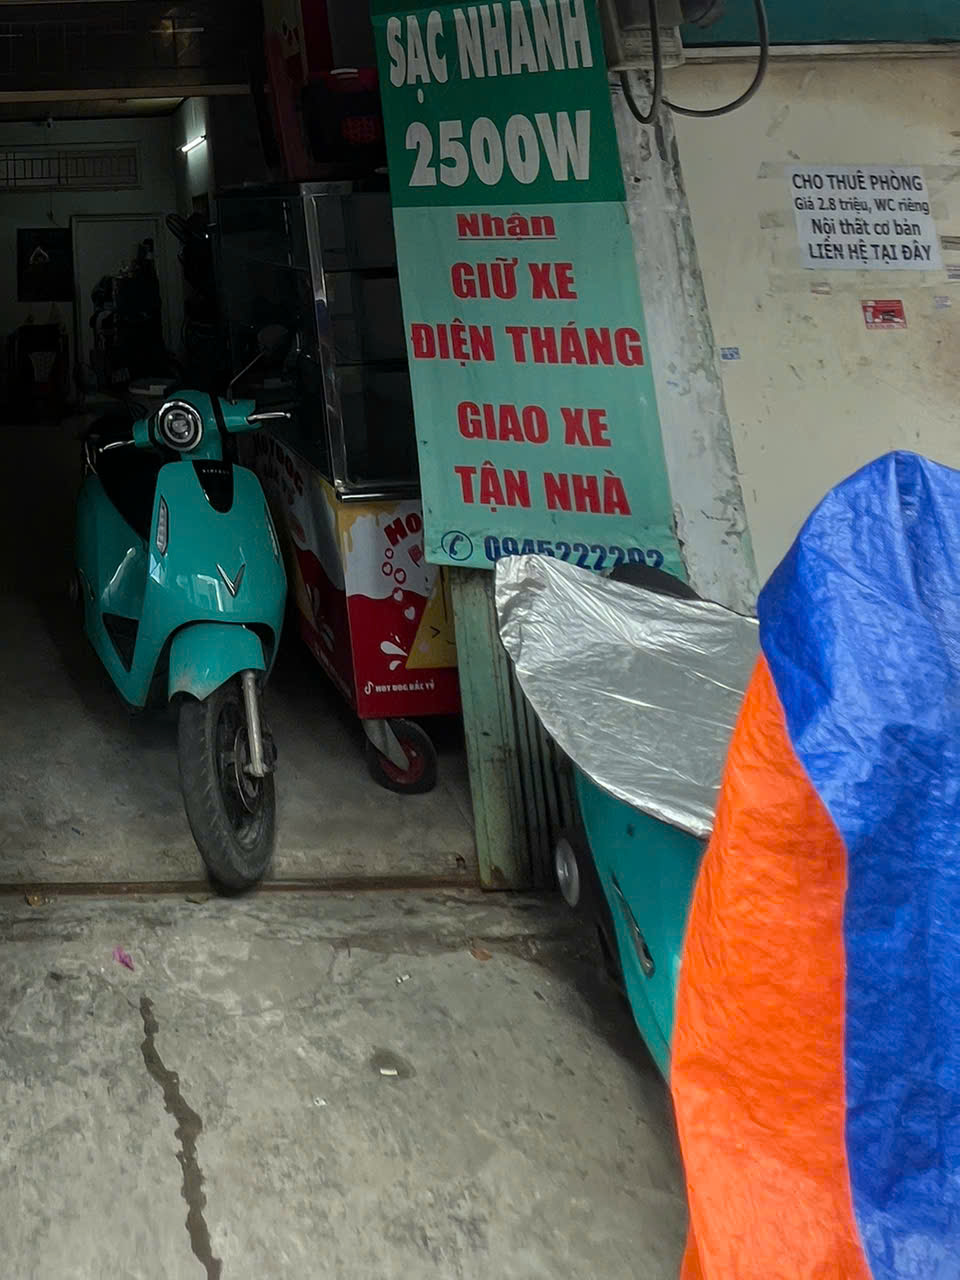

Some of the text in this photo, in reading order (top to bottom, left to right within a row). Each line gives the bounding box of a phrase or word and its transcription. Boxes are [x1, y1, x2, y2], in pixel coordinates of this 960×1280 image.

[386, 10, 449, 104] SẠC
[405, 110, 591, 188] 2500W
[792, 170, 923, 191] CHO THUÊ PHÒNG
[456, 213, 557, 241] Nhận
[794, 197, 815, 210] Giá
[818, 197, 837, 211] 2.8
[874, 198, 896, 211] WC
[898, 197, 930, 215] riêng
[811, 217, 922, 238] Nội thất cơ bản
[808, 237, 844, 260] LIÊN
[847, 239, 869, 264] HỆ
[870, 243, 898, 264] TẠI
[902, 240, 933, 261] ĐÂY
[451, 257, 579, 300] GIỮ XE
[410, 317, 645, 367] ĐIỆN THÁNG
[456, 401, 612, 447] GIAO XE
[454, 460, 633, 516] TẬN NHÀ
